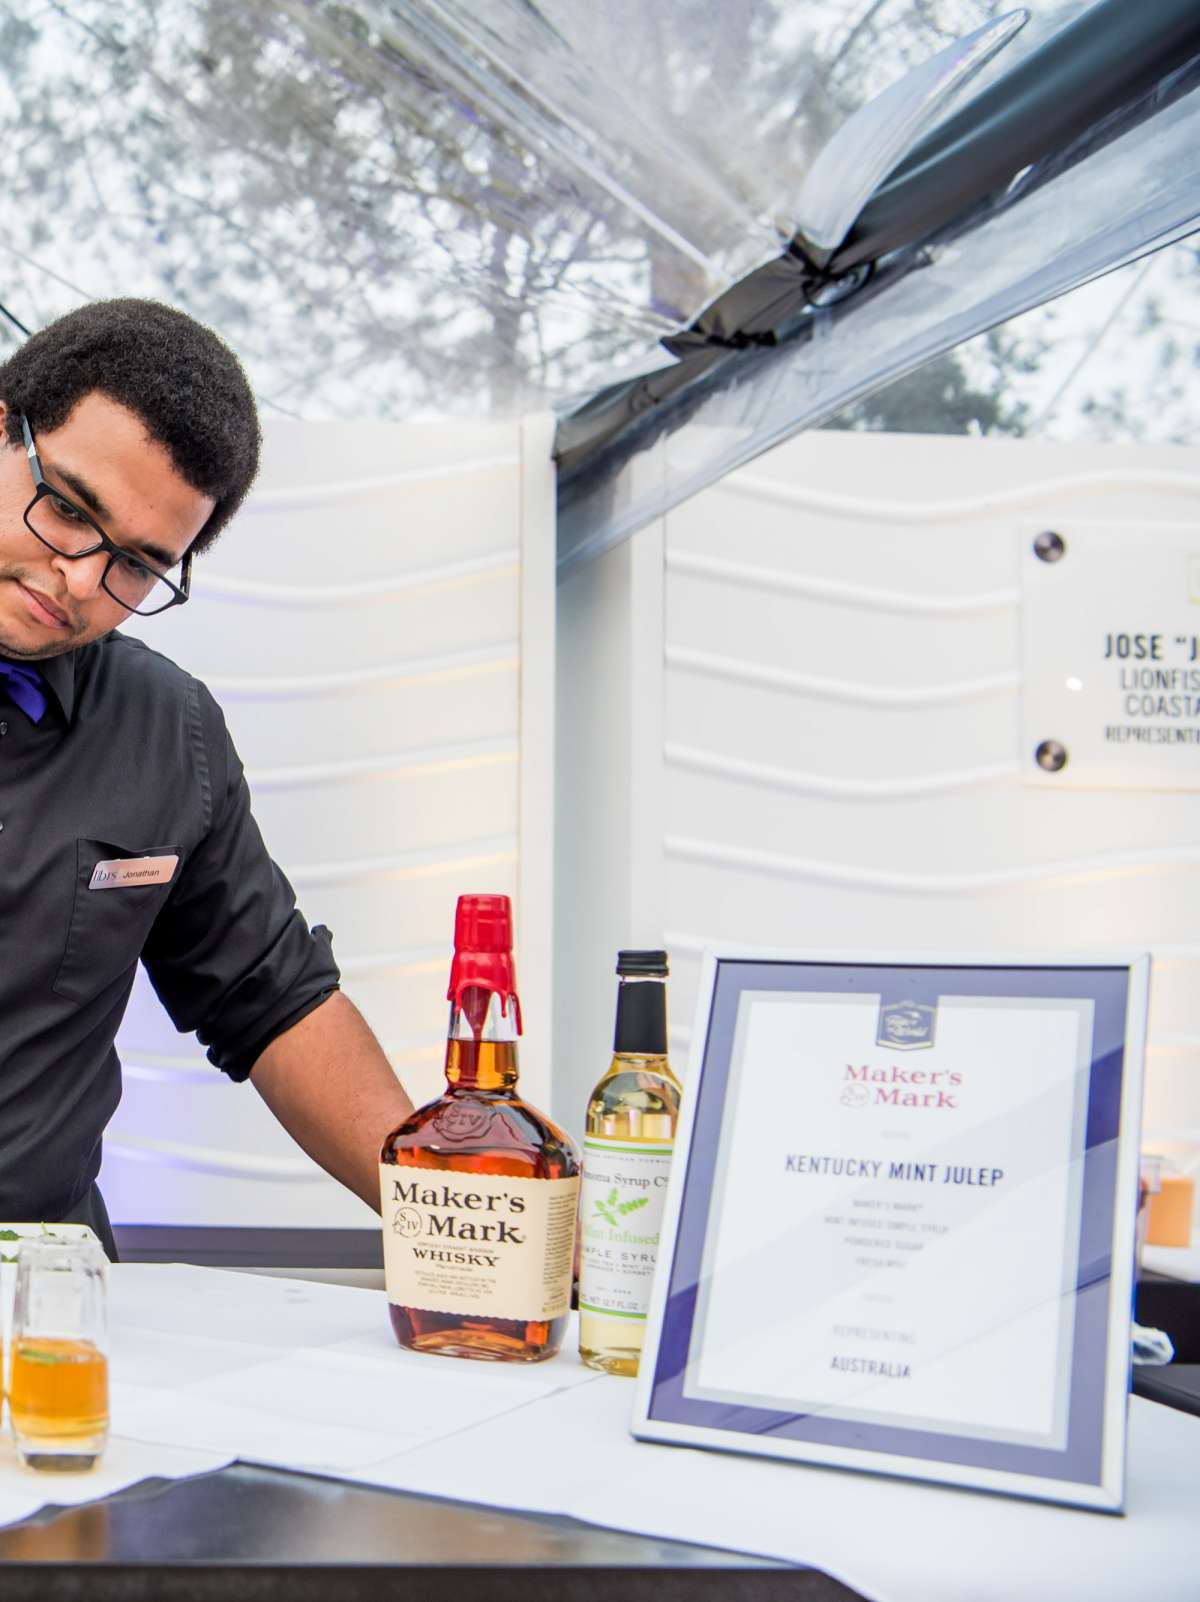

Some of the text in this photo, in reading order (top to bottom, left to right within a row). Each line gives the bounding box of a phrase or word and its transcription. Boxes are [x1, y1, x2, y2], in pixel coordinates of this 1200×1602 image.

[1103, 633, 1163, 660] JOSE
[1119, 667, 1200, 692] LIONFIS
[122, 870, 160, 880] Jonathan
[843, 1063, 963, 1086] Maker's
[873, 1087, 957, 1109] Mark
[613, 1172, 651, 1190] Syrup
[785, 1154, 1005, 1188] KENTUCKY MINT JULEP
[392, 1180, 526, 1214] Maker's
[426, 1213, 524, 1245] Mark
[412, 1247, 501, 1267] WHISKY
[830, 1355, 911, 1379] AUSTRALIA
